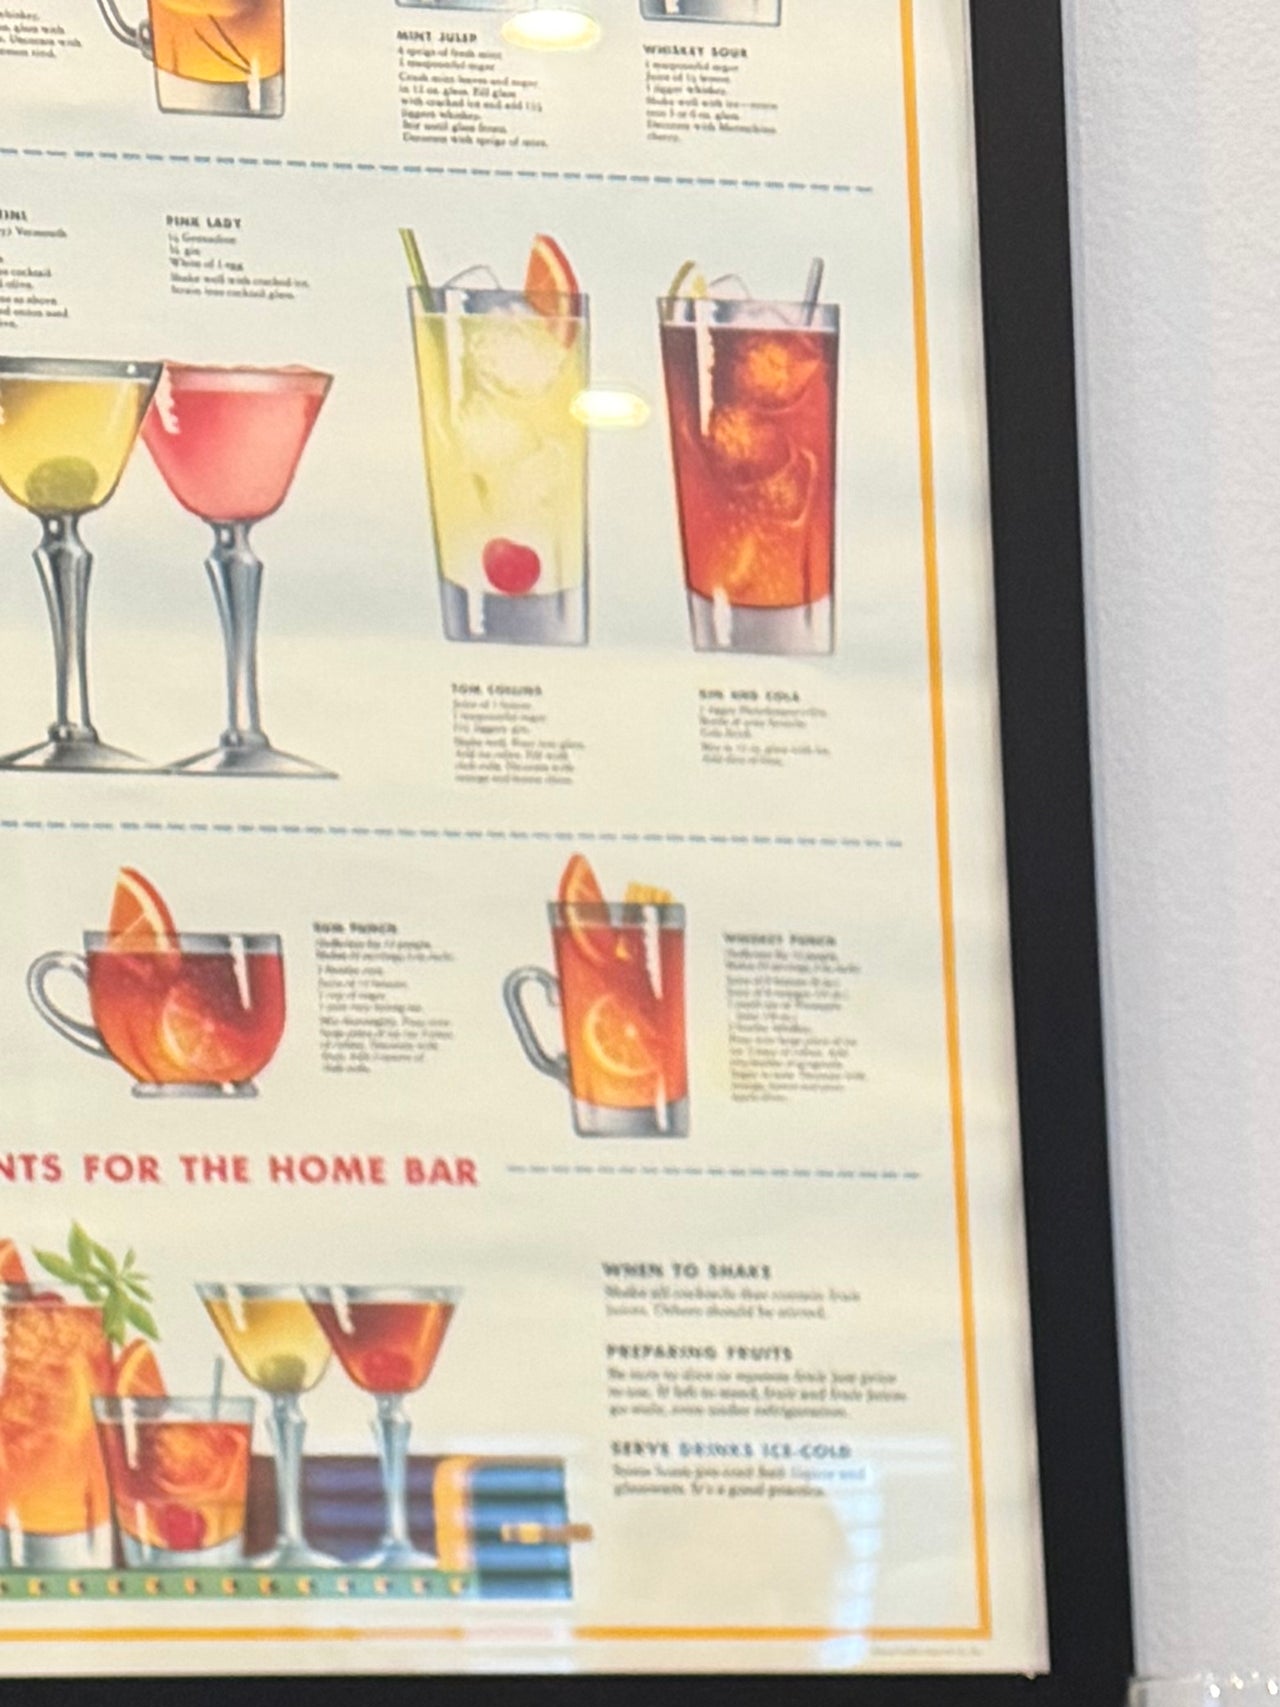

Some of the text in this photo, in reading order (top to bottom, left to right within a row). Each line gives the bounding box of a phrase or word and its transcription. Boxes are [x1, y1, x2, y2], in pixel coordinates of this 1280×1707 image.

[397, 31, 432, 41] MINT
[166, 214, 241, 229] PINK LADY
[83, 1153, 161, 1184] FOR
[179, 1153, 250, 1184] THE
[269, 1153, 387, 1185] HOME
[405, 1155, 478, 1186] BAR
[601, 1262, 772, 1280] WHEN TO SHAKE
[606, 1343, 793, 1362] PREPARING FRUITS
